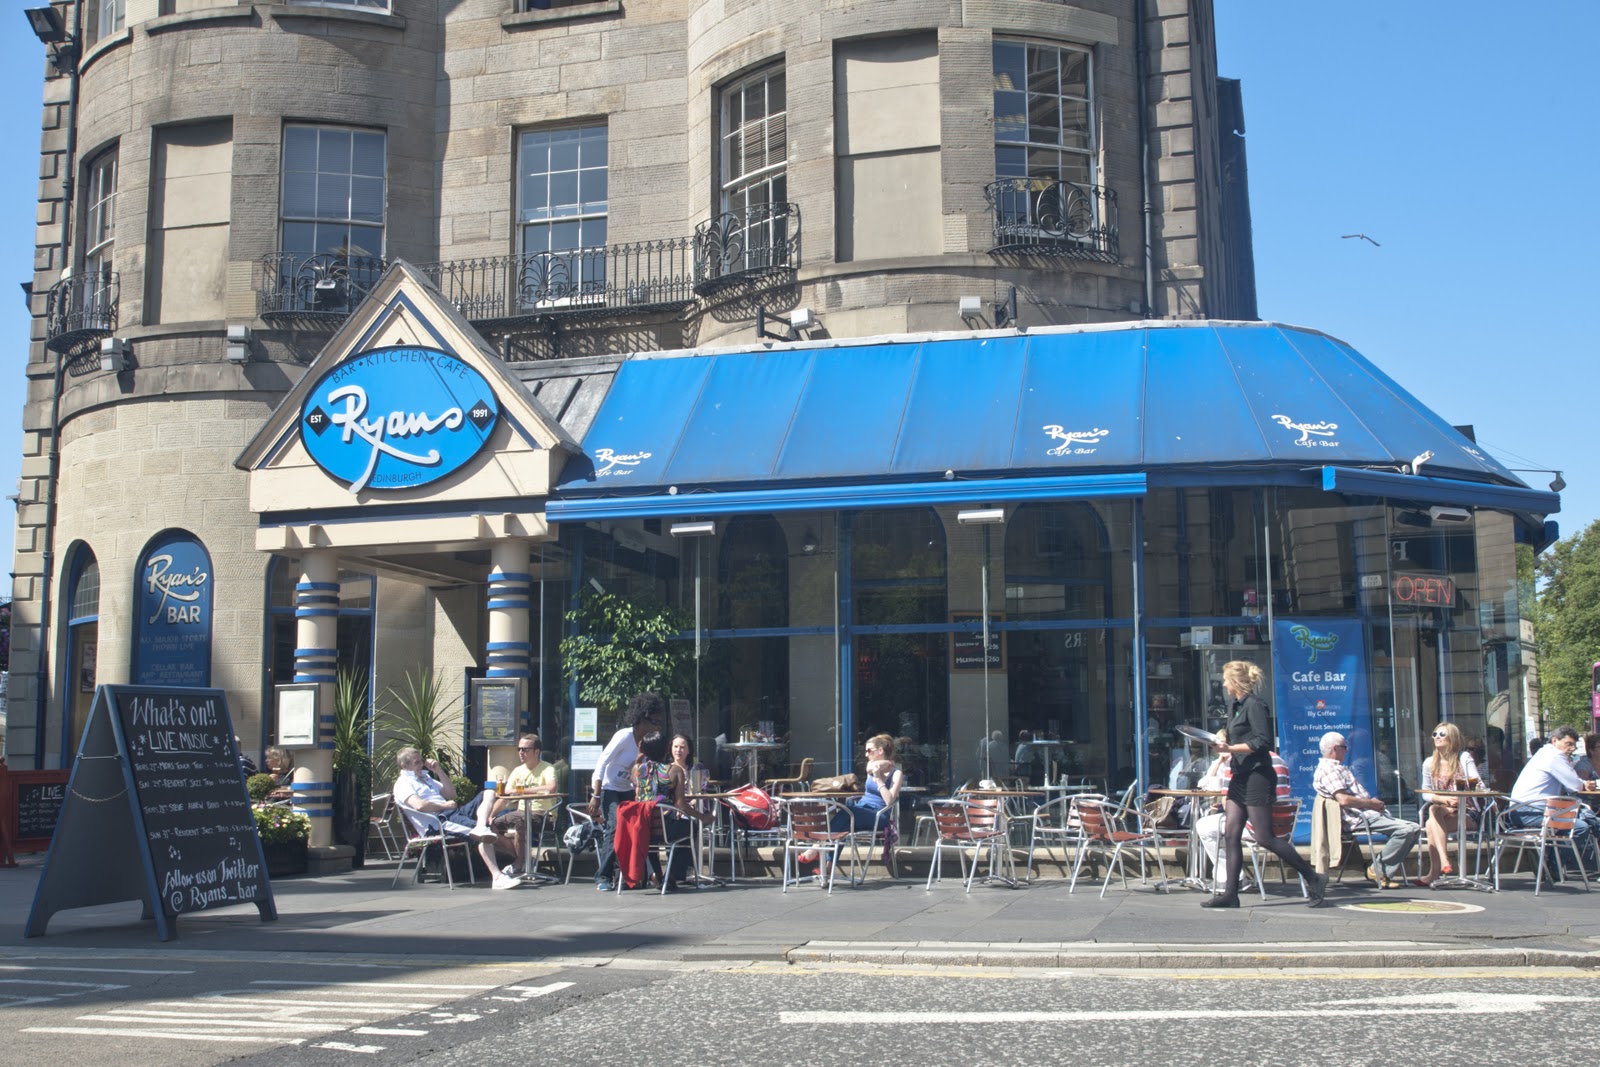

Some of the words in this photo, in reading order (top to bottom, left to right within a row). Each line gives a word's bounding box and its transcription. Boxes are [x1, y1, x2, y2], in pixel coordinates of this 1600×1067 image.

[331, 362, 360, 384] BAR
[365, 350, 430, 367] KITCHEN
[310, 414, 322, 423] EST
[472, 408, 488, 418] 1991
[1042, 424, 1110, 450] Ryan's
[1271, 414, 1338, 441] Ryan's
[595, 448, 652, 472] Ryan's
[372, 472, 422, 482] EDINBURGH
[148, 554, 208, 624] Ryan's
[1396, 576, 1451, 604] OPEN
[167, 606, 200, 624] BAR
[1292, 670, 1320, 682] Cafe
[1324, 671, 1346, 682] Bar
[130, 696, 186, 726] What's
[148, 730, 178, 750] LIVE
[180, 732, 213, 749] MUSIC
[42, 786, 62, 800] LIVE
[218, 857, 259, 883] Twitter
